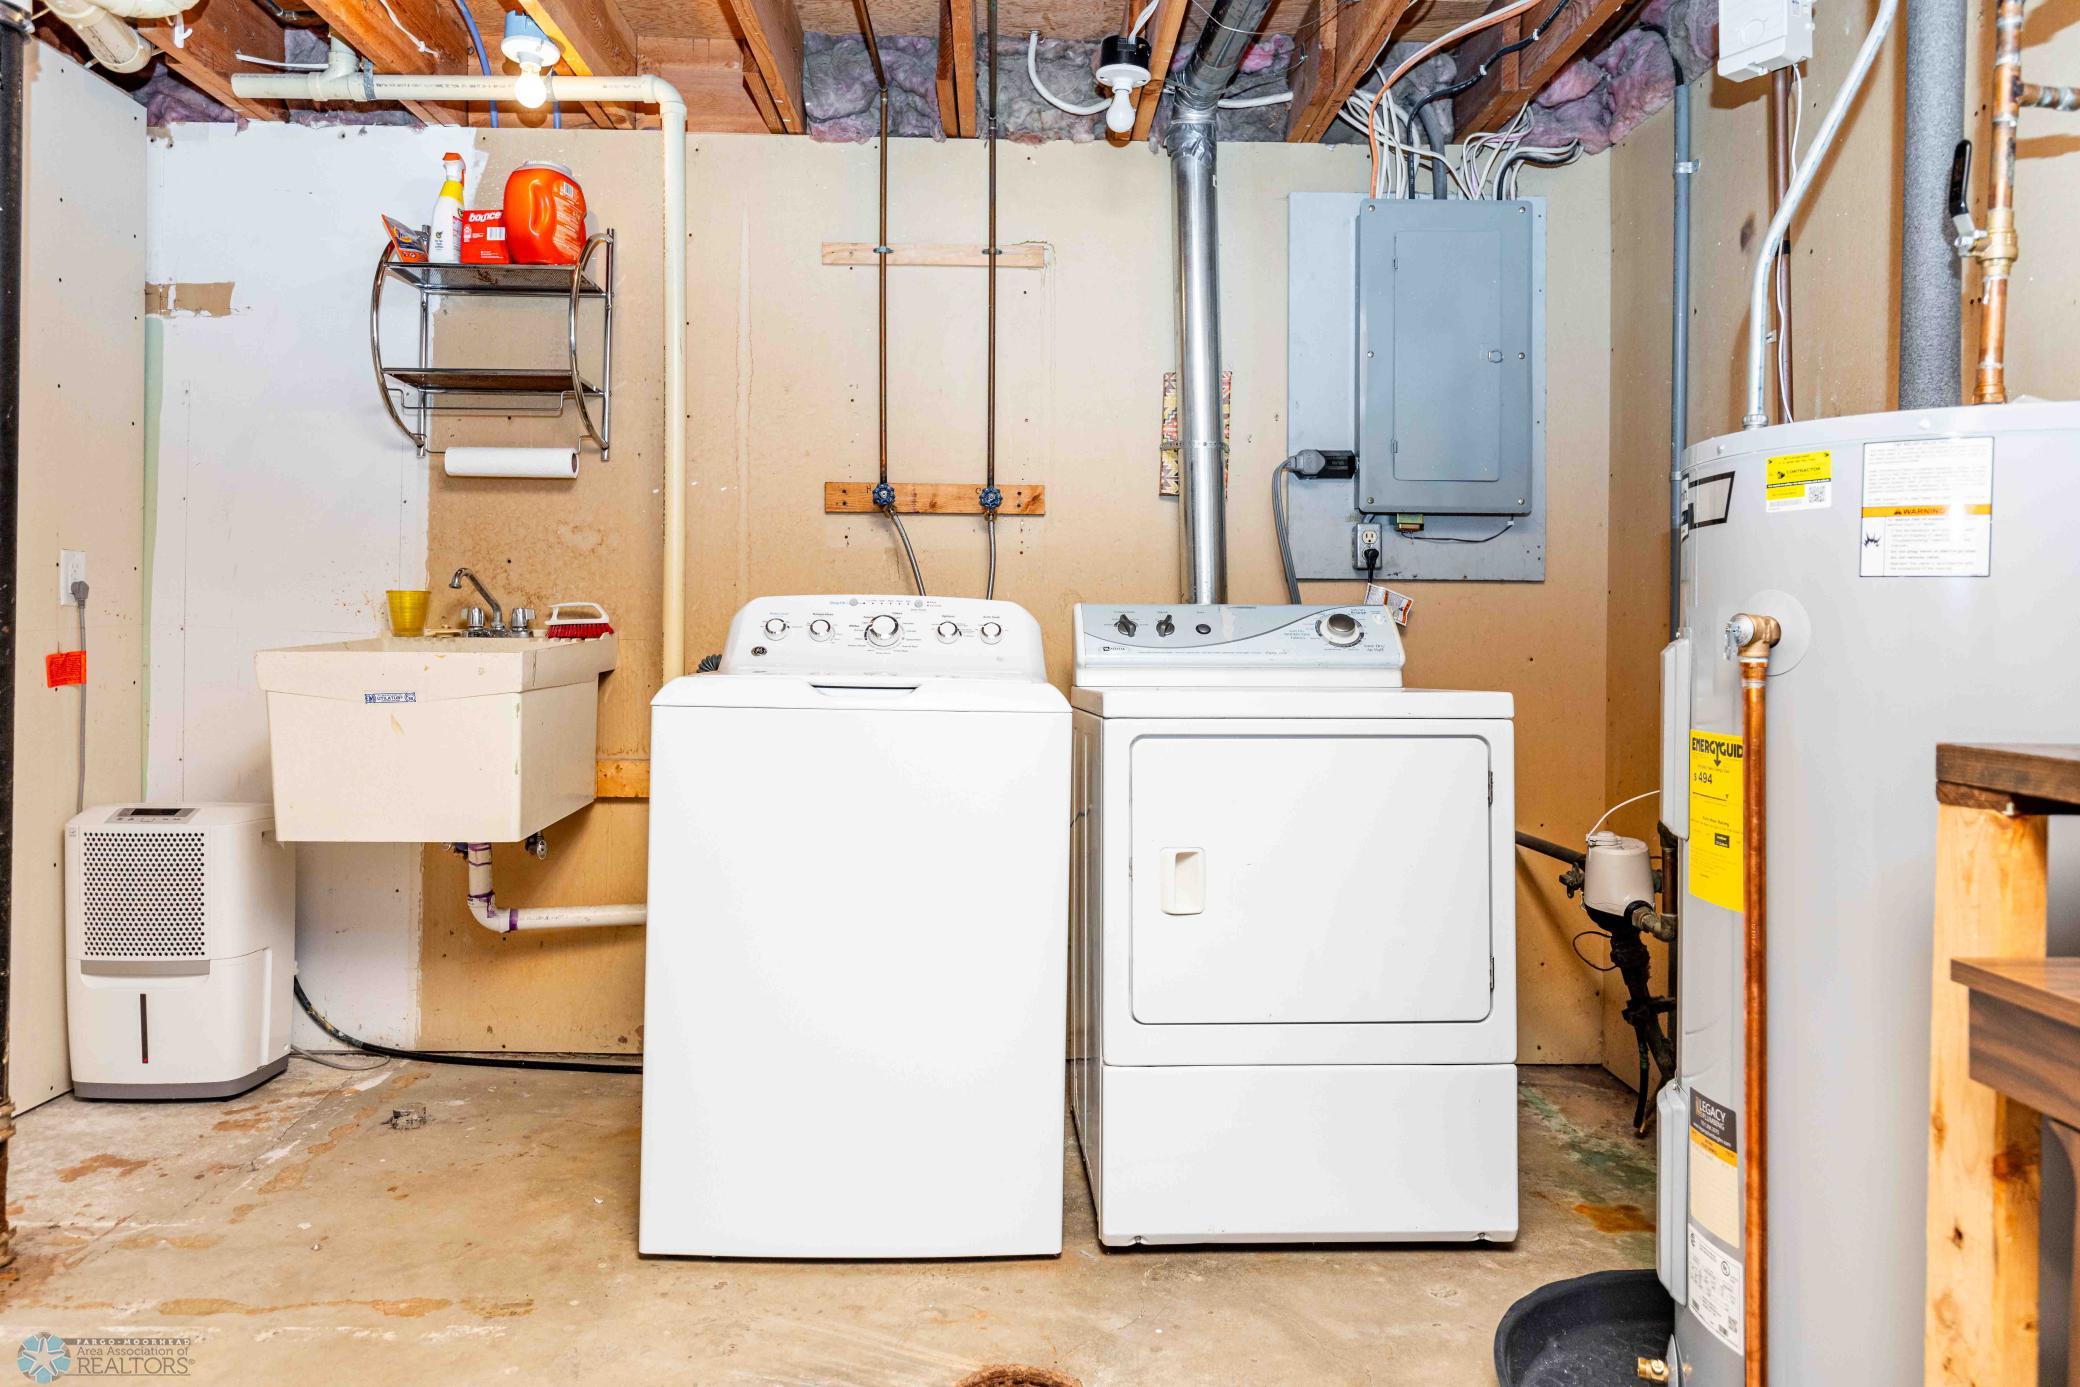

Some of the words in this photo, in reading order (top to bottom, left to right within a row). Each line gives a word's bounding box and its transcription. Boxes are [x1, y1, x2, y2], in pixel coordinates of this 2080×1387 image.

[468, 211, 503, 223] bounce
[1903, 507, 1945, 516] WARNING
[1692, 737, 1744, 760] ENERGYGUID
[1698, 771, 1713, 785] 494
[1699, 1099, 1726, 1123] LEGACY
